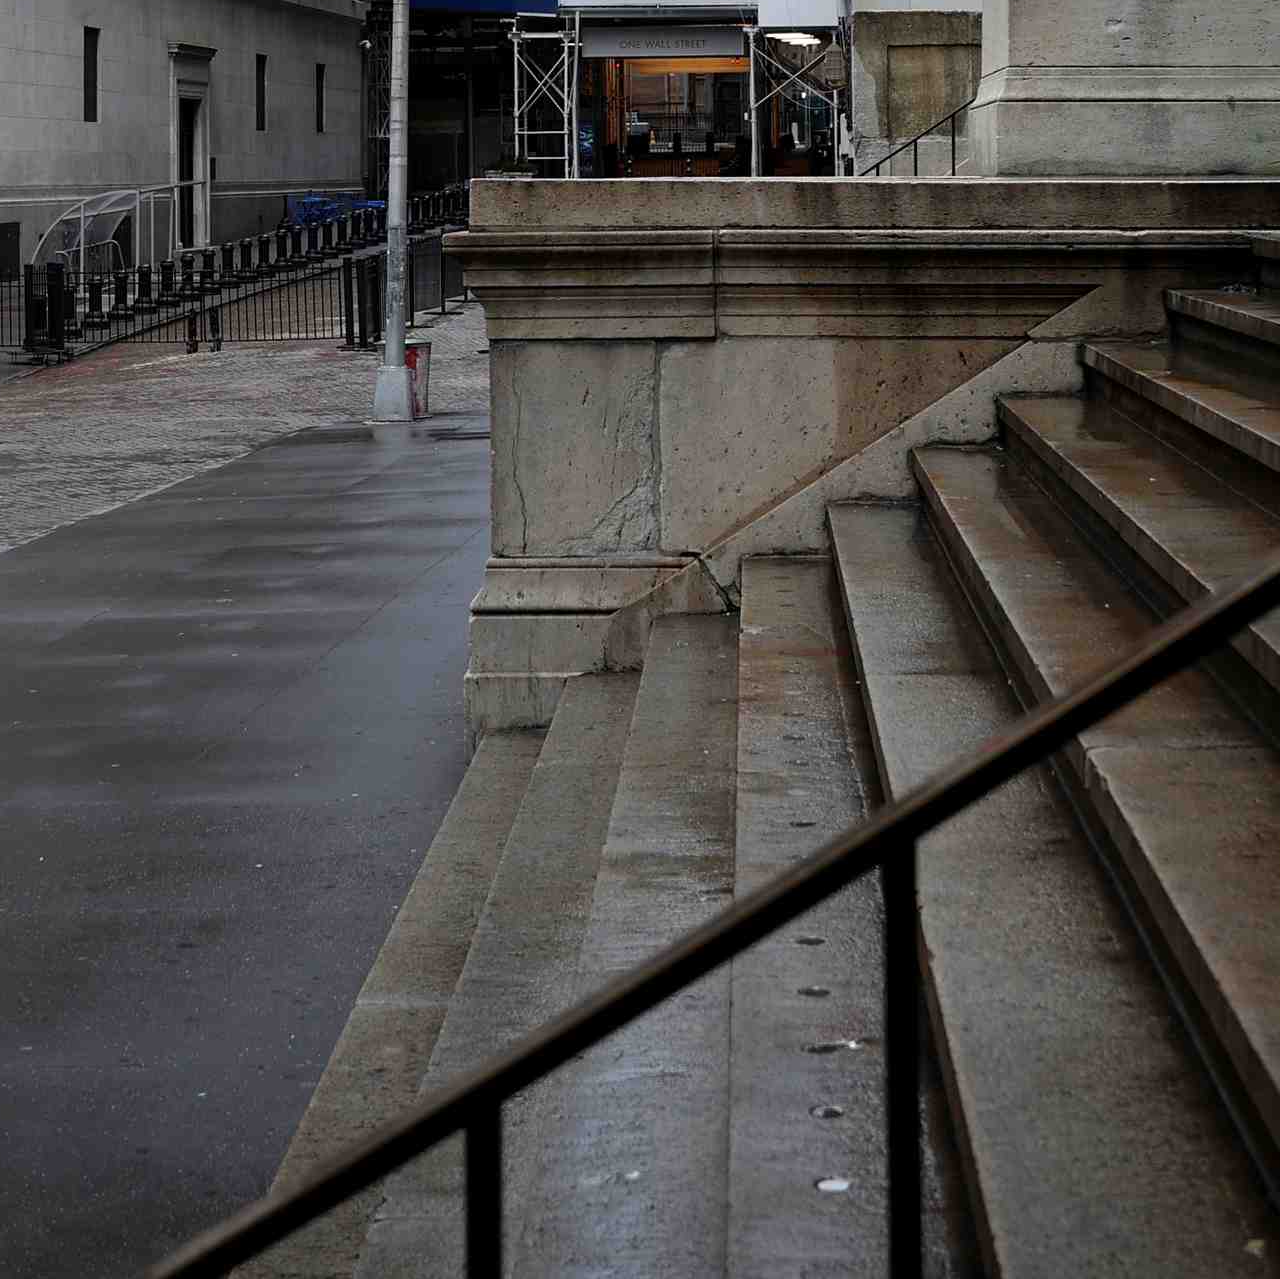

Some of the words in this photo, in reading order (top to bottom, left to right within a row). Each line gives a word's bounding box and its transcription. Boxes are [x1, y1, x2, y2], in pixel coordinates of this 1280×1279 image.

[620, 40, 641, 49] ONE
[645, 40, 670, 49] WALL
[674, 40, 706, 49] STREET
